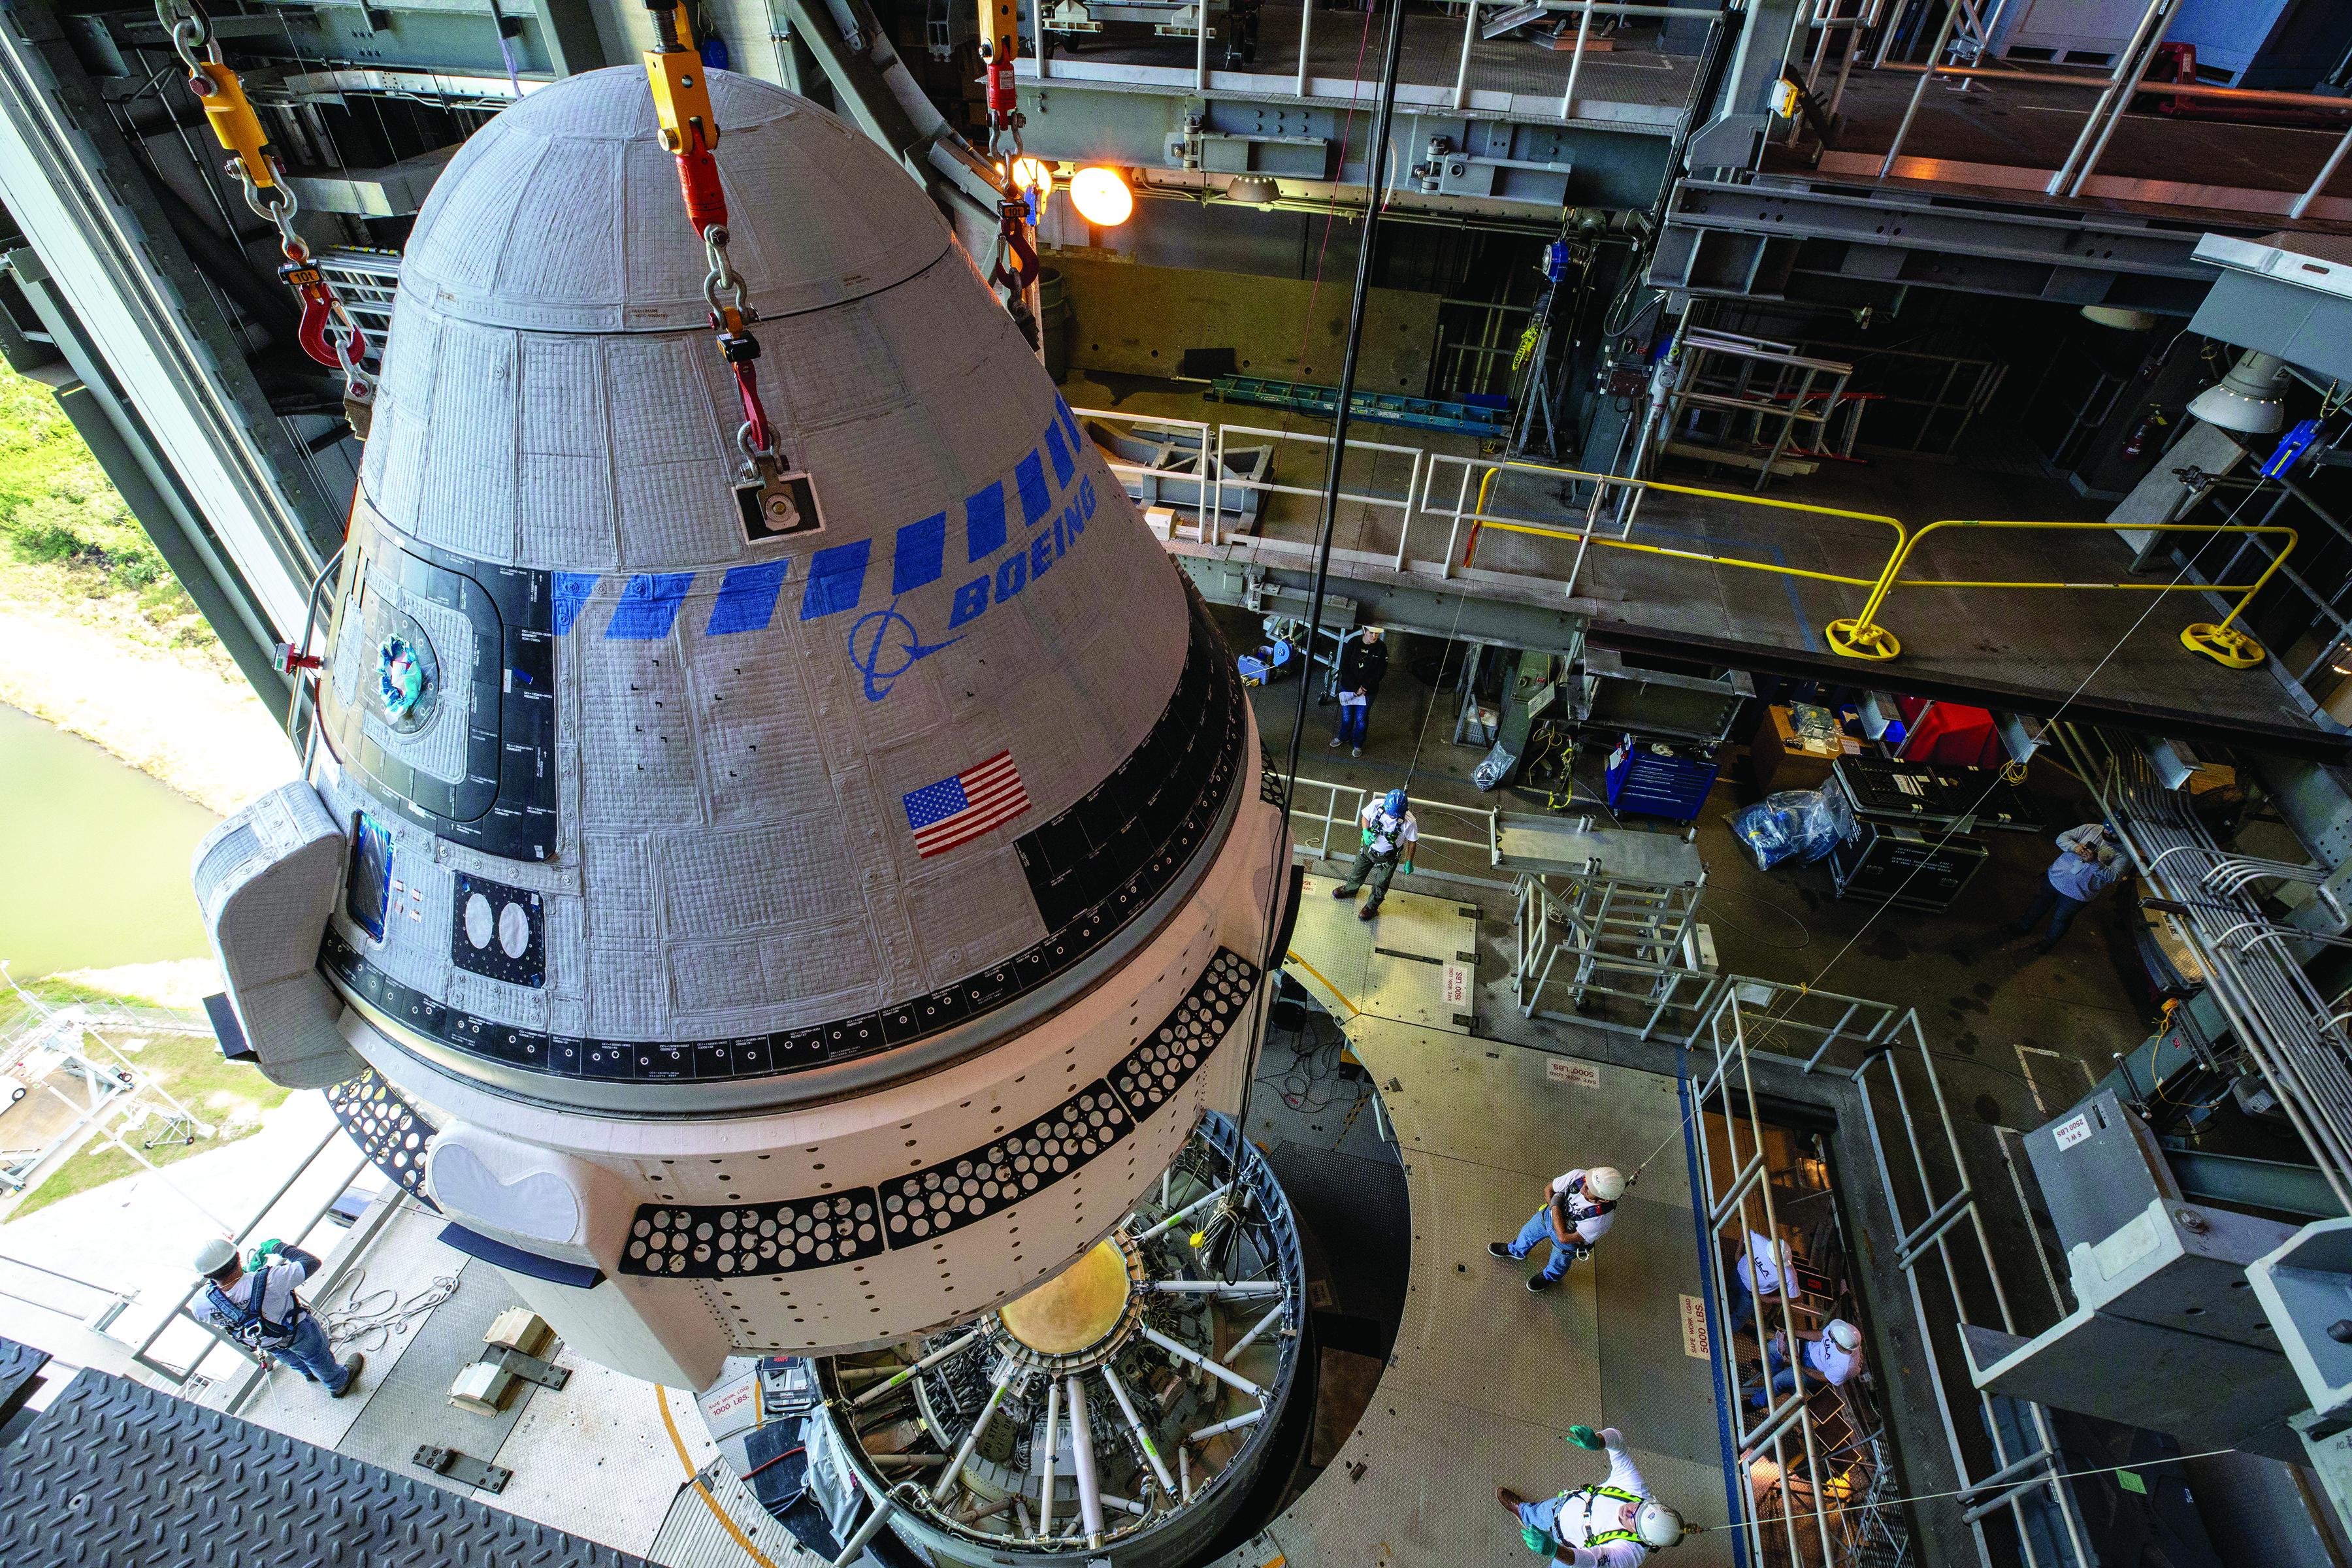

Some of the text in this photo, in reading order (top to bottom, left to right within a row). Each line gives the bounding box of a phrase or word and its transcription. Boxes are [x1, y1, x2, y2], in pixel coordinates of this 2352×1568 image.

[294, 271, 315, 283] 10t
[948, 474, 1098, 630] BOEING
[1552, 1063, 1594, 1077] 5000 LBS.
[2057, 1119, 2083, 1137] 2500 LBS
[1754, 1256, 1770, 1278] ULA
[1695, 1303, 1708, 1354] 5000 LBS.
[709, 1385, 749, 1409] SAFE WORK LOAD
[713, 1394, 749, 1416] 1000 LBS.
[988, 1418, 1000, 1439] STEP
